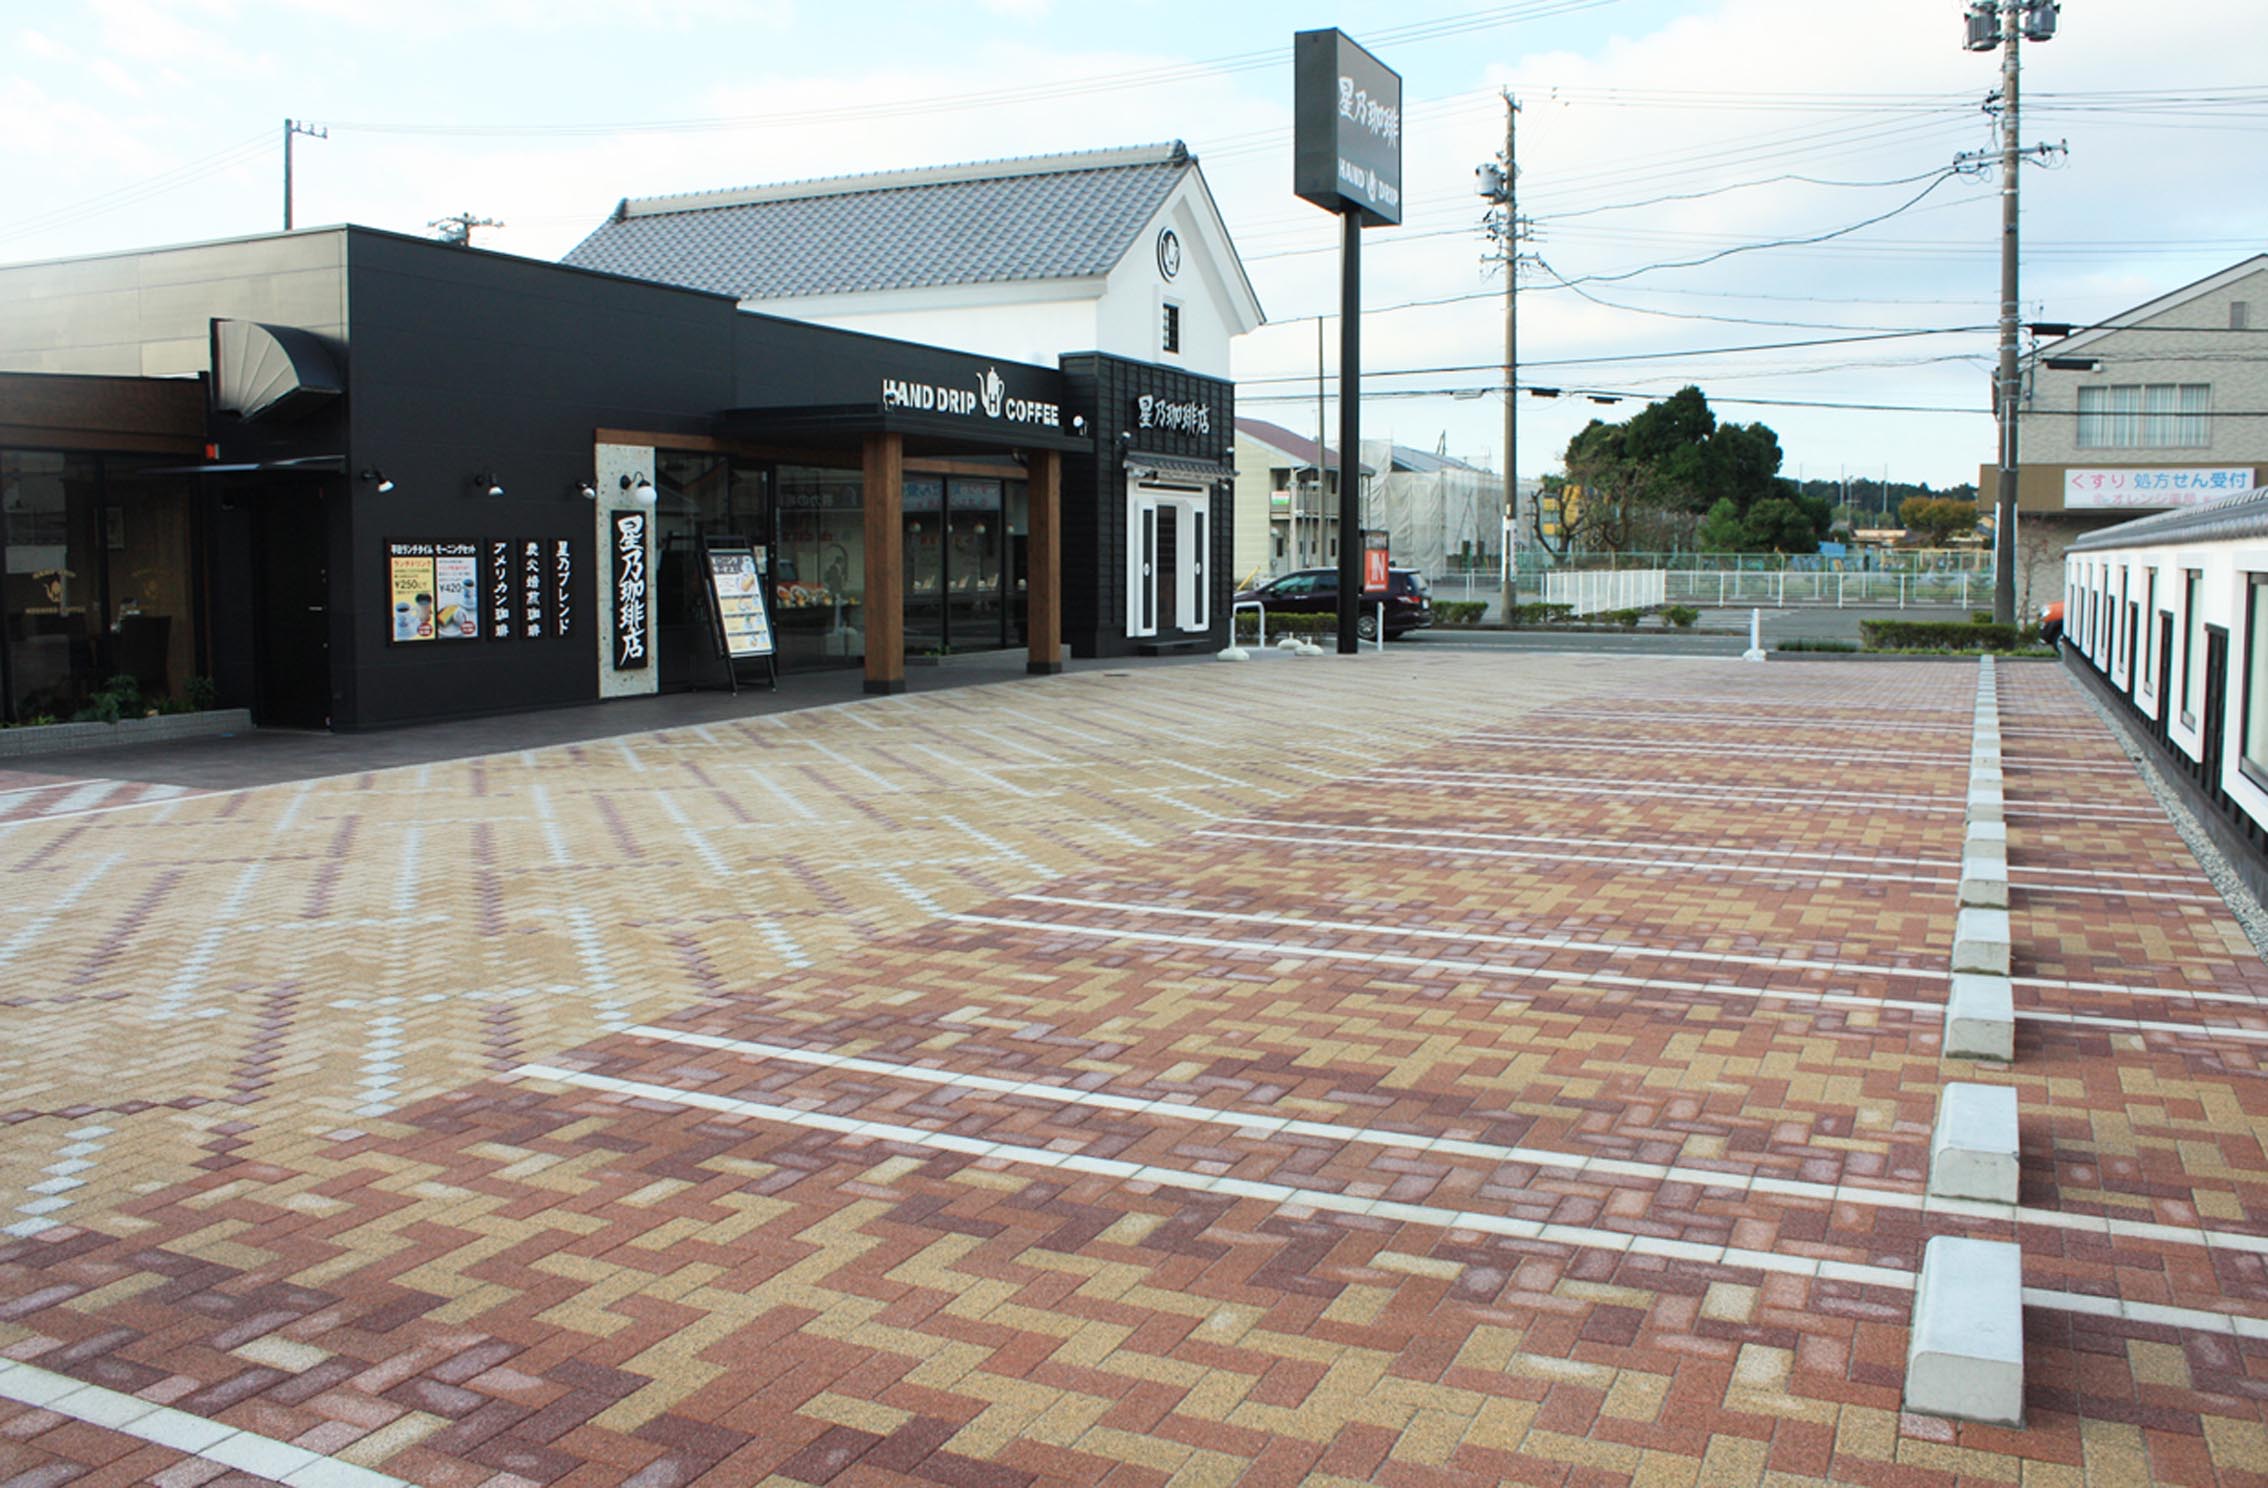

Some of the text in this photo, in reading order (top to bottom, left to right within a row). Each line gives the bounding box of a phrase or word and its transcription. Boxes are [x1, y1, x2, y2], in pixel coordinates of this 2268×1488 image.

[1338, 157, 1398, 207] HAND DRIP
[883, 378, 1060, 427] HAND DRIP COFFEE
[1138, 394, 1210, 436] 星乃珈琲店
[2071, 472, 2247, 489] くすり 処方せん受付
[494, 542, 510, 637] アメリカン珈琲
[617, 515, 645, 666] 星乃珈琲店
